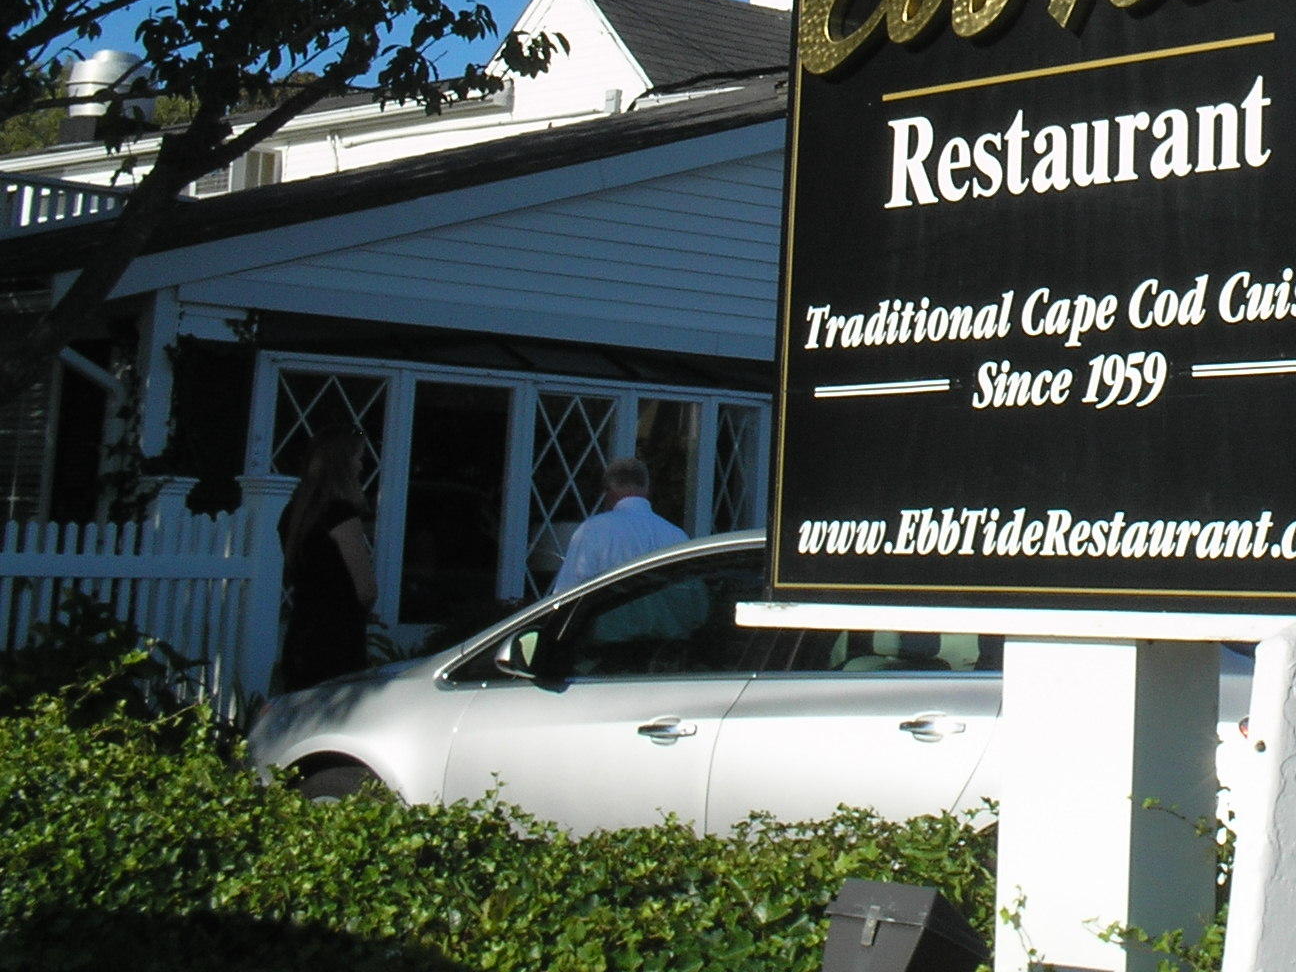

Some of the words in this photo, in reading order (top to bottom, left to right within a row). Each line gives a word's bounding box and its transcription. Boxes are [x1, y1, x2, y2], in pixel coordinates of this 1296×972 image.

[883, 75, 1272, 209] Restaurant
[804, 290, 1012, 349] Traditional
[1022, 288, 1117, 347] Cape
[1128, 275, 1208, 328] Cod
[972, 360, 1071, 408] Since
[1082, 352, 1167, 408] 1959
